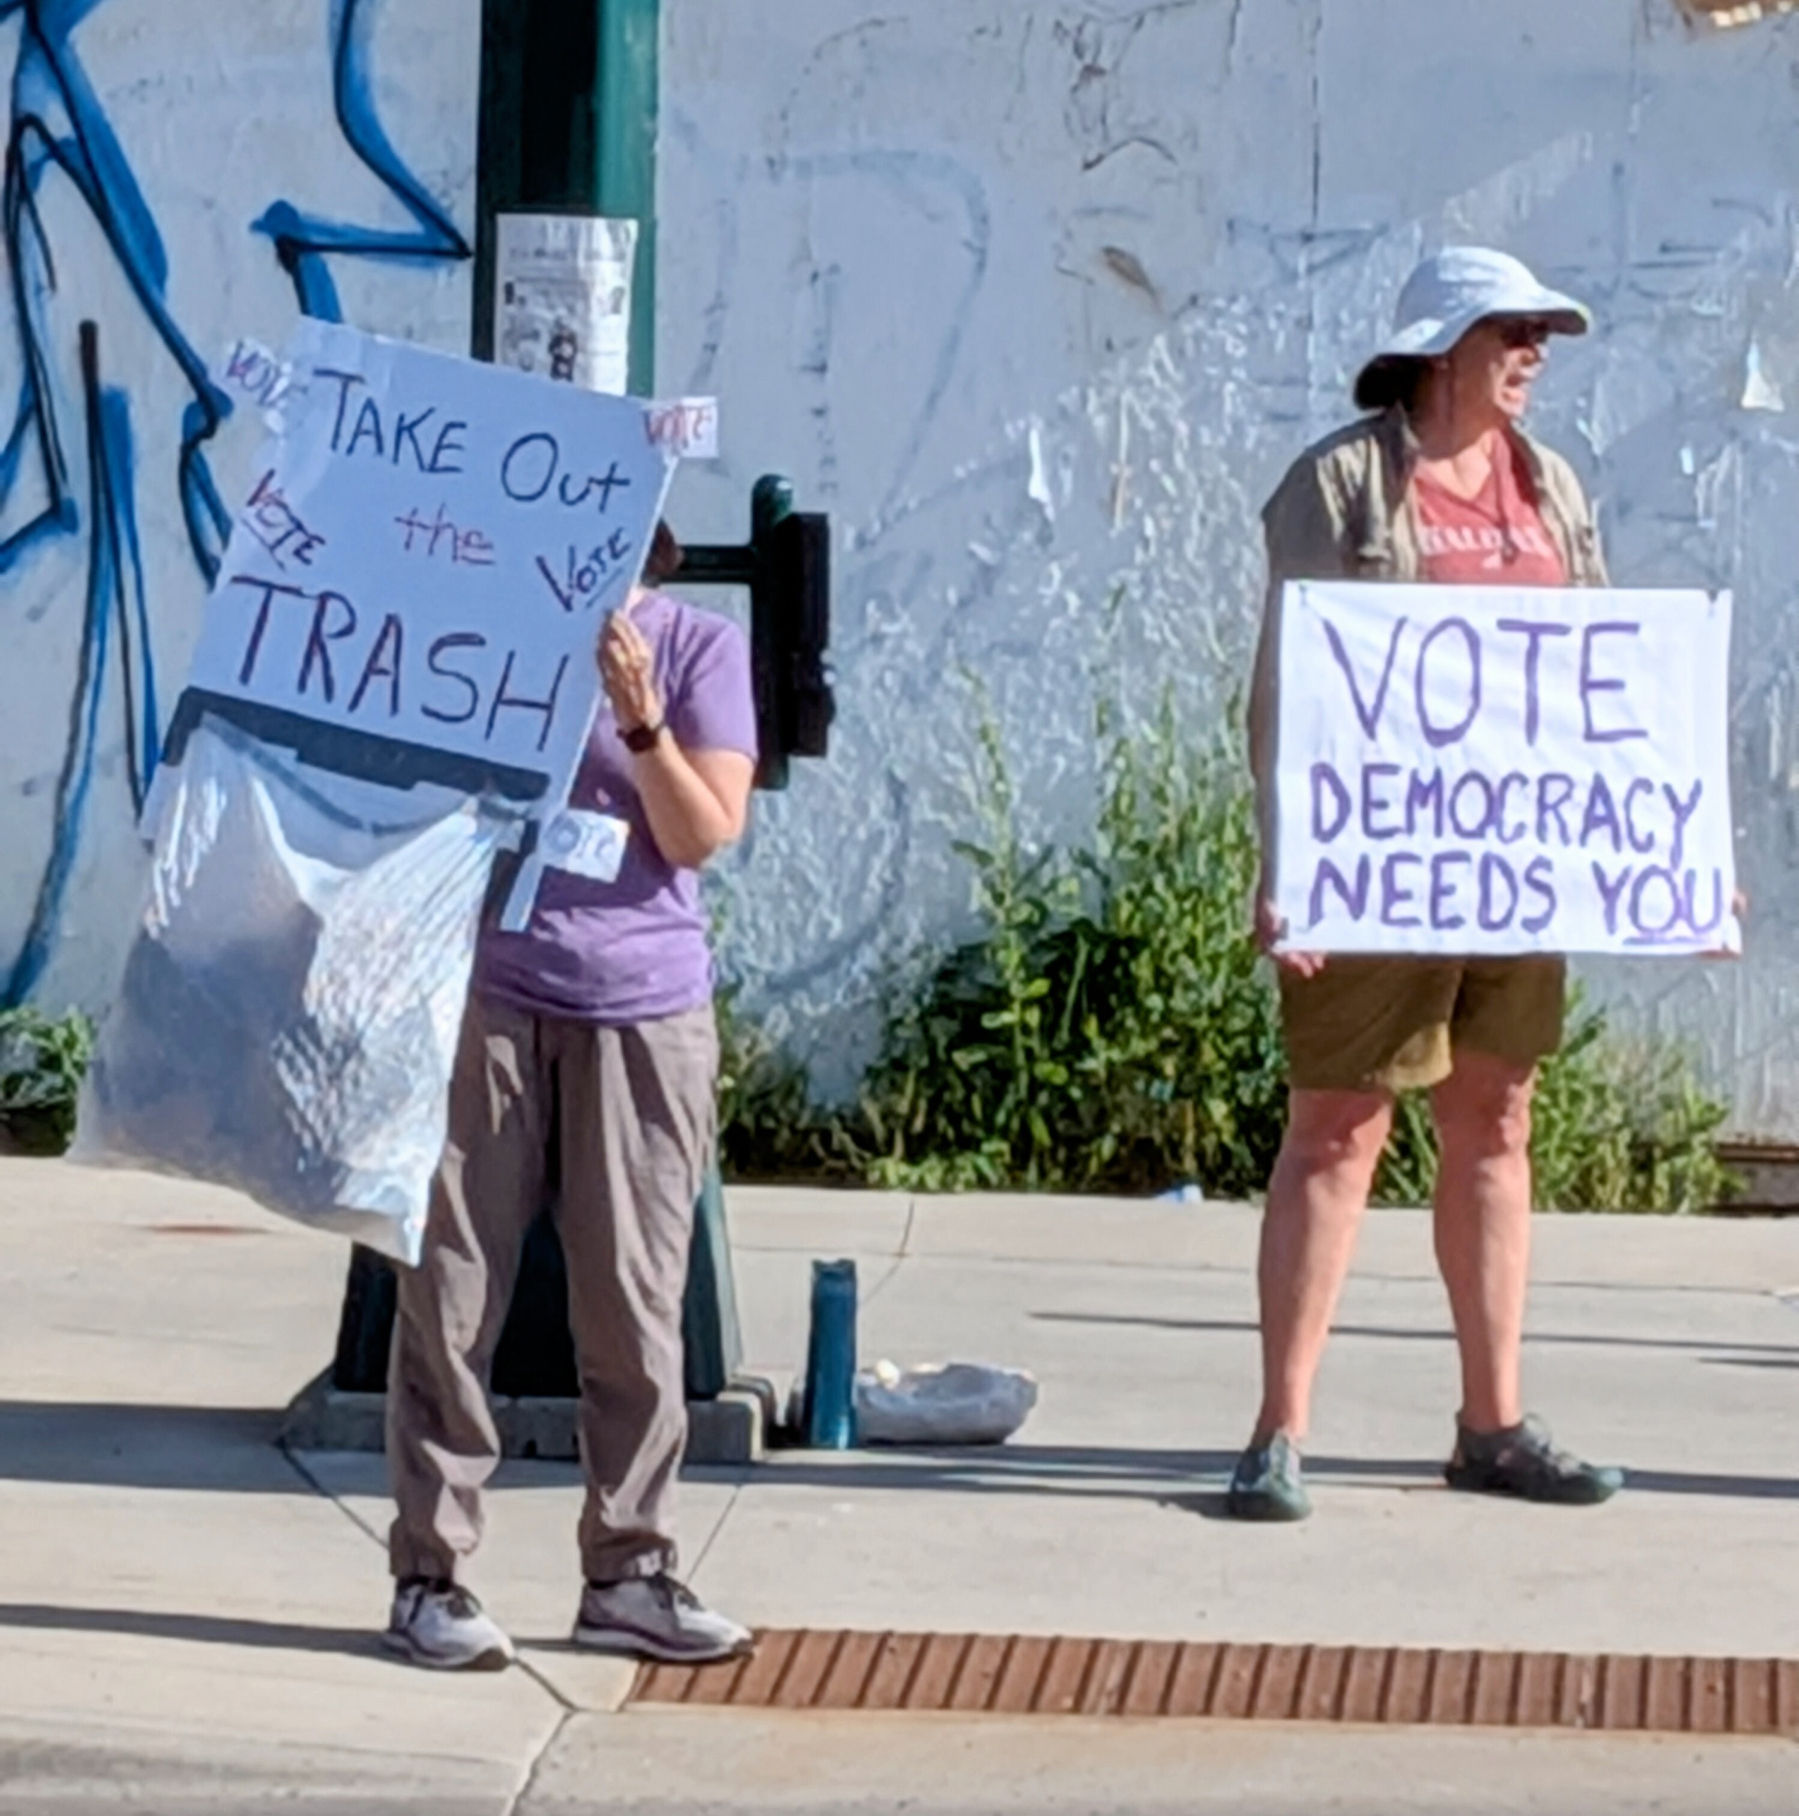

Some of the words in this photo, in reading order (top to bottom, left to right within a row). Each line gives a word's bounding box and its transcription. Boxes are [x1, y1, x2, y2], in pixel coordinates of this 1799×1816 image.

[313, 367, 468, 475] TAKE
[500, 432, 631, 512] Out
[246, 468, 327, 566] VOTE
[395, 502, 495, 564] the
[535, 527, 633, 612] VOTE
[231, 574, 570, 752] TRASH
[1322, 615, 1649, 748] VOTE
[1309, 762, 1703, 872] DEMOCRACY
[1307, 850, 1557, 935] NEEDS
[1592, 861, 1724, 936] YOU
